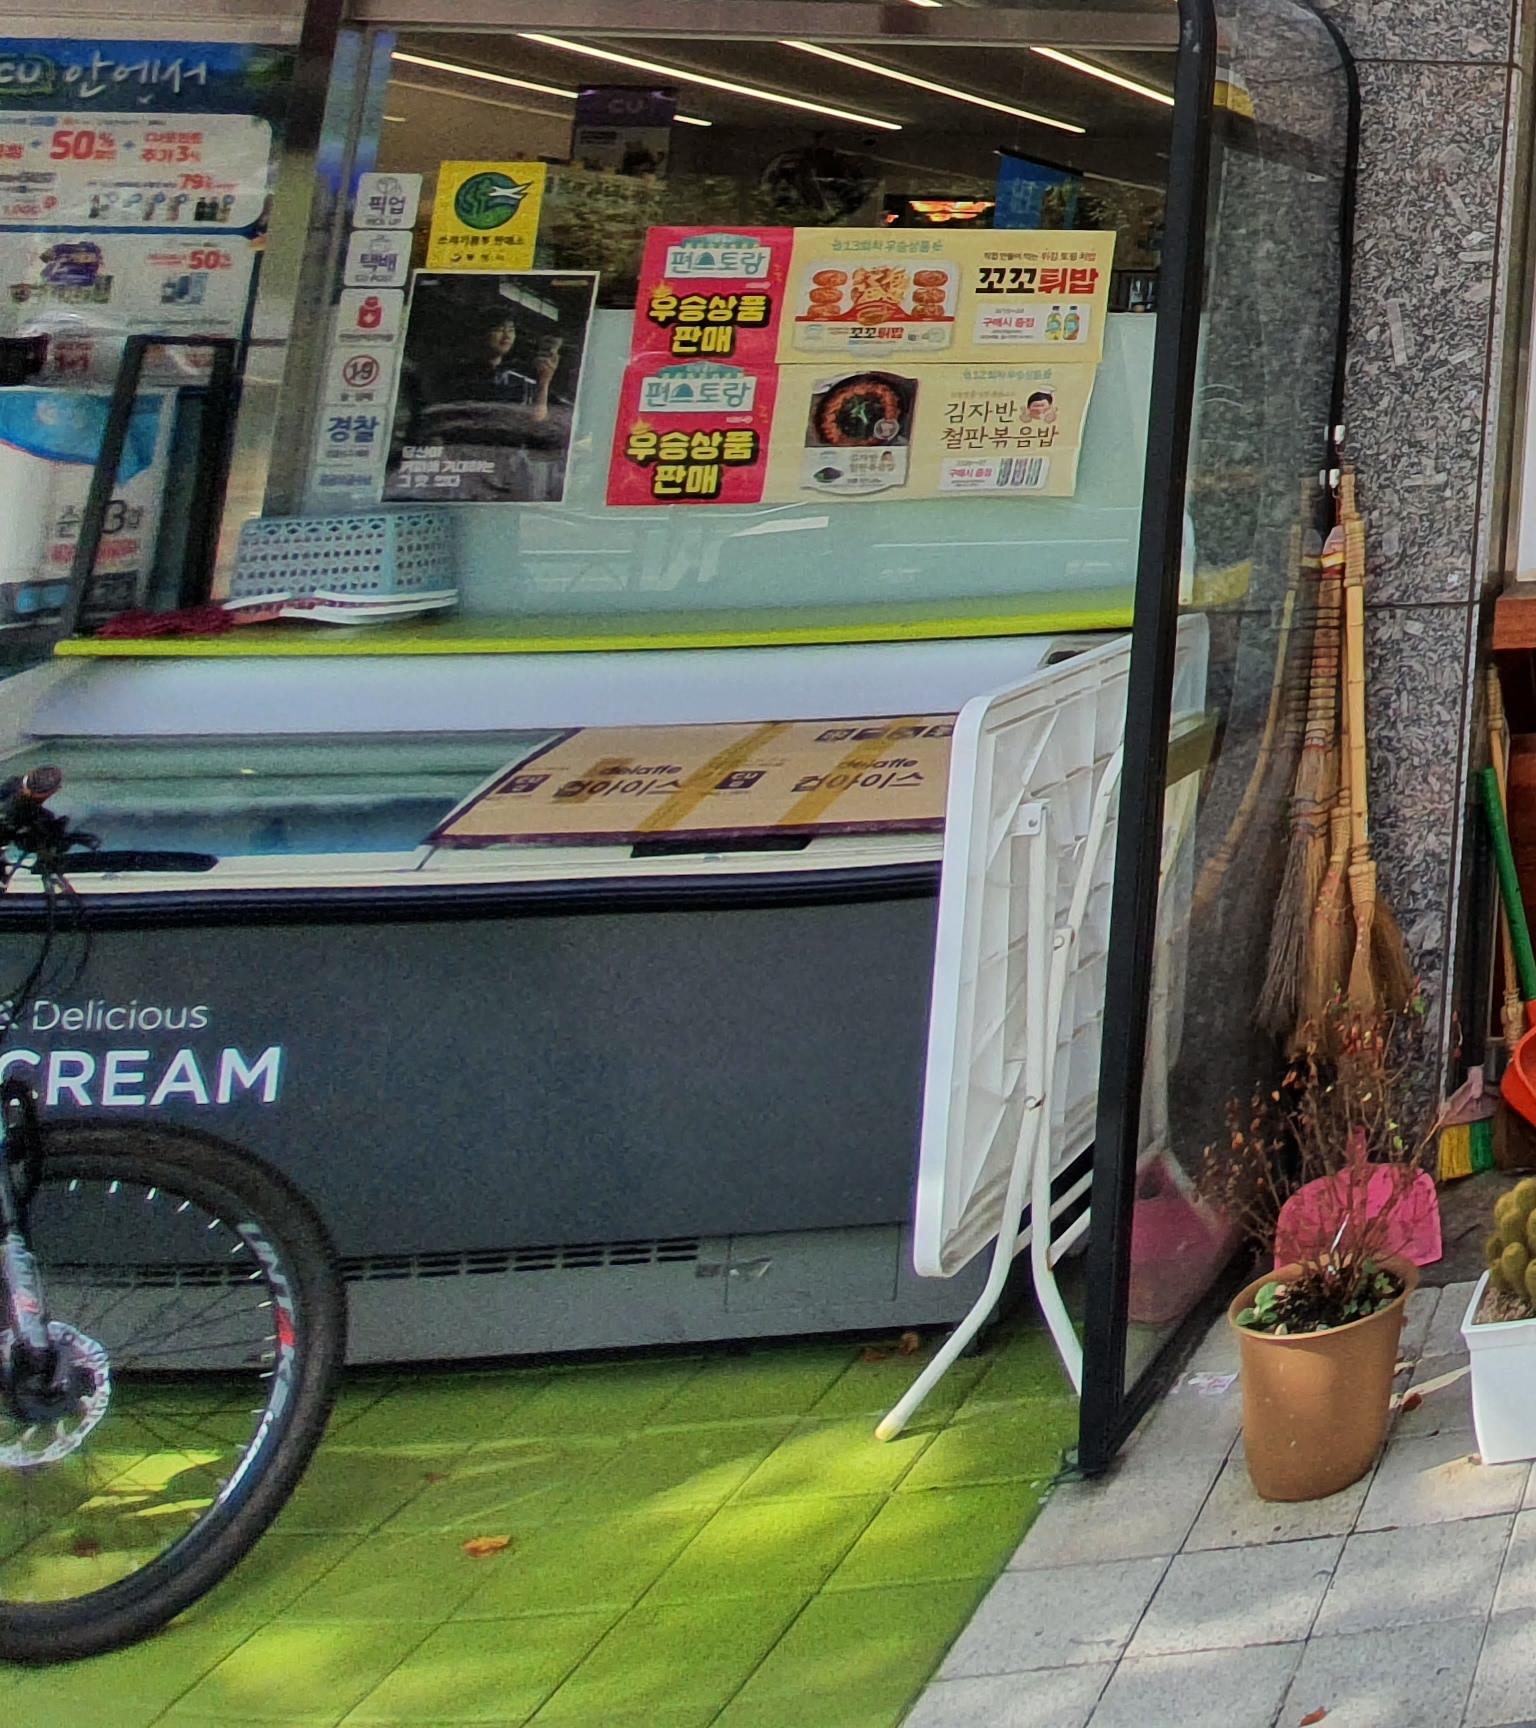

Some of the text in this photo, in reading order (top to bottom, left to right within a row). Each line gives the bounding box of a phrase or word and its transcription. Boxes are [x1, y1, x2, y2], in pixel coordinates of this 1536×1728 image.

[975, 268, 1098, 294] 꼬꼬튀밥
[649, 295, 767, 322] 우승상품
[672, 326, 733, 353] 판매
[944, 400, 1017, 424] 김자반
[328, 415, 379, 443] 경찰
[941, 425, 1059, 450] 철판볶음밥
[627, 431, 753, 460] 우승상품
[654, 465, 718, 494] 판매
[32, 999, 209, 1031] Delicious
